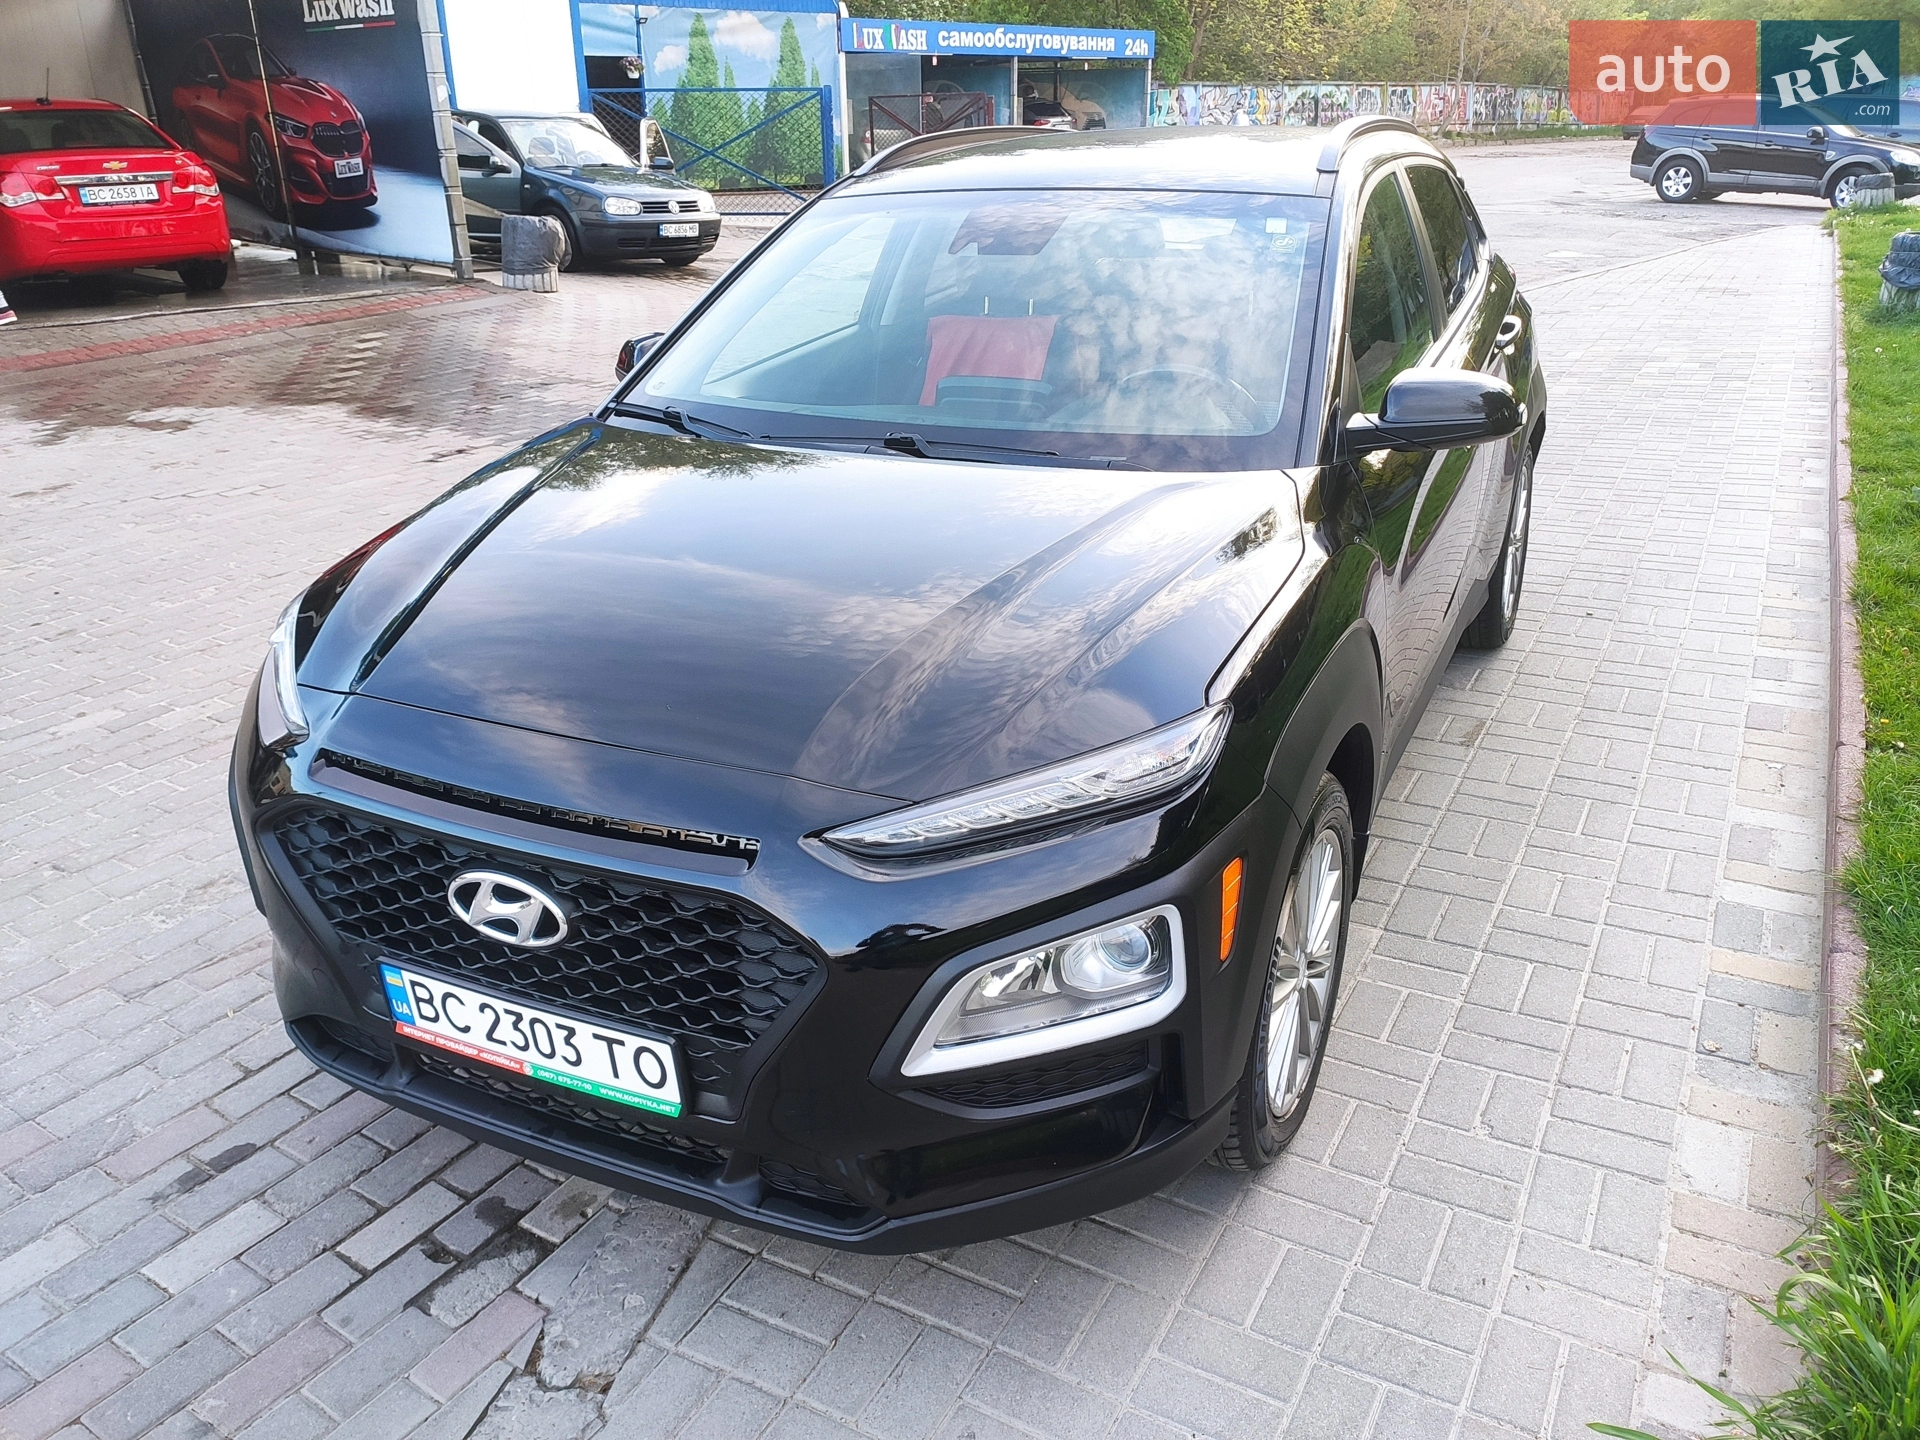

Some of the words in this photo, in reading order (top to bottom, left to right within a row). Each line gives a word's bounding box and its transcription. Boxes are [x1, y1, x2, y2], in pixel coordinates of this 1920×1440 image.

[938, 28, 1115, 54] самообслуговування
[1124, 38, 1149, 55] 24h
[88, 189, 106, 200] BC
[110, 187, 137, 199] 2658
[140, 186, 155, 198] IA
[663, 225, 673, 235] BC
[393, 1000, 412, 1017] UA
[409, 979, 472, 1034] BC
[478, 1003, 583, 1068] 2303
[592, 1032, 668, 1090] TO
